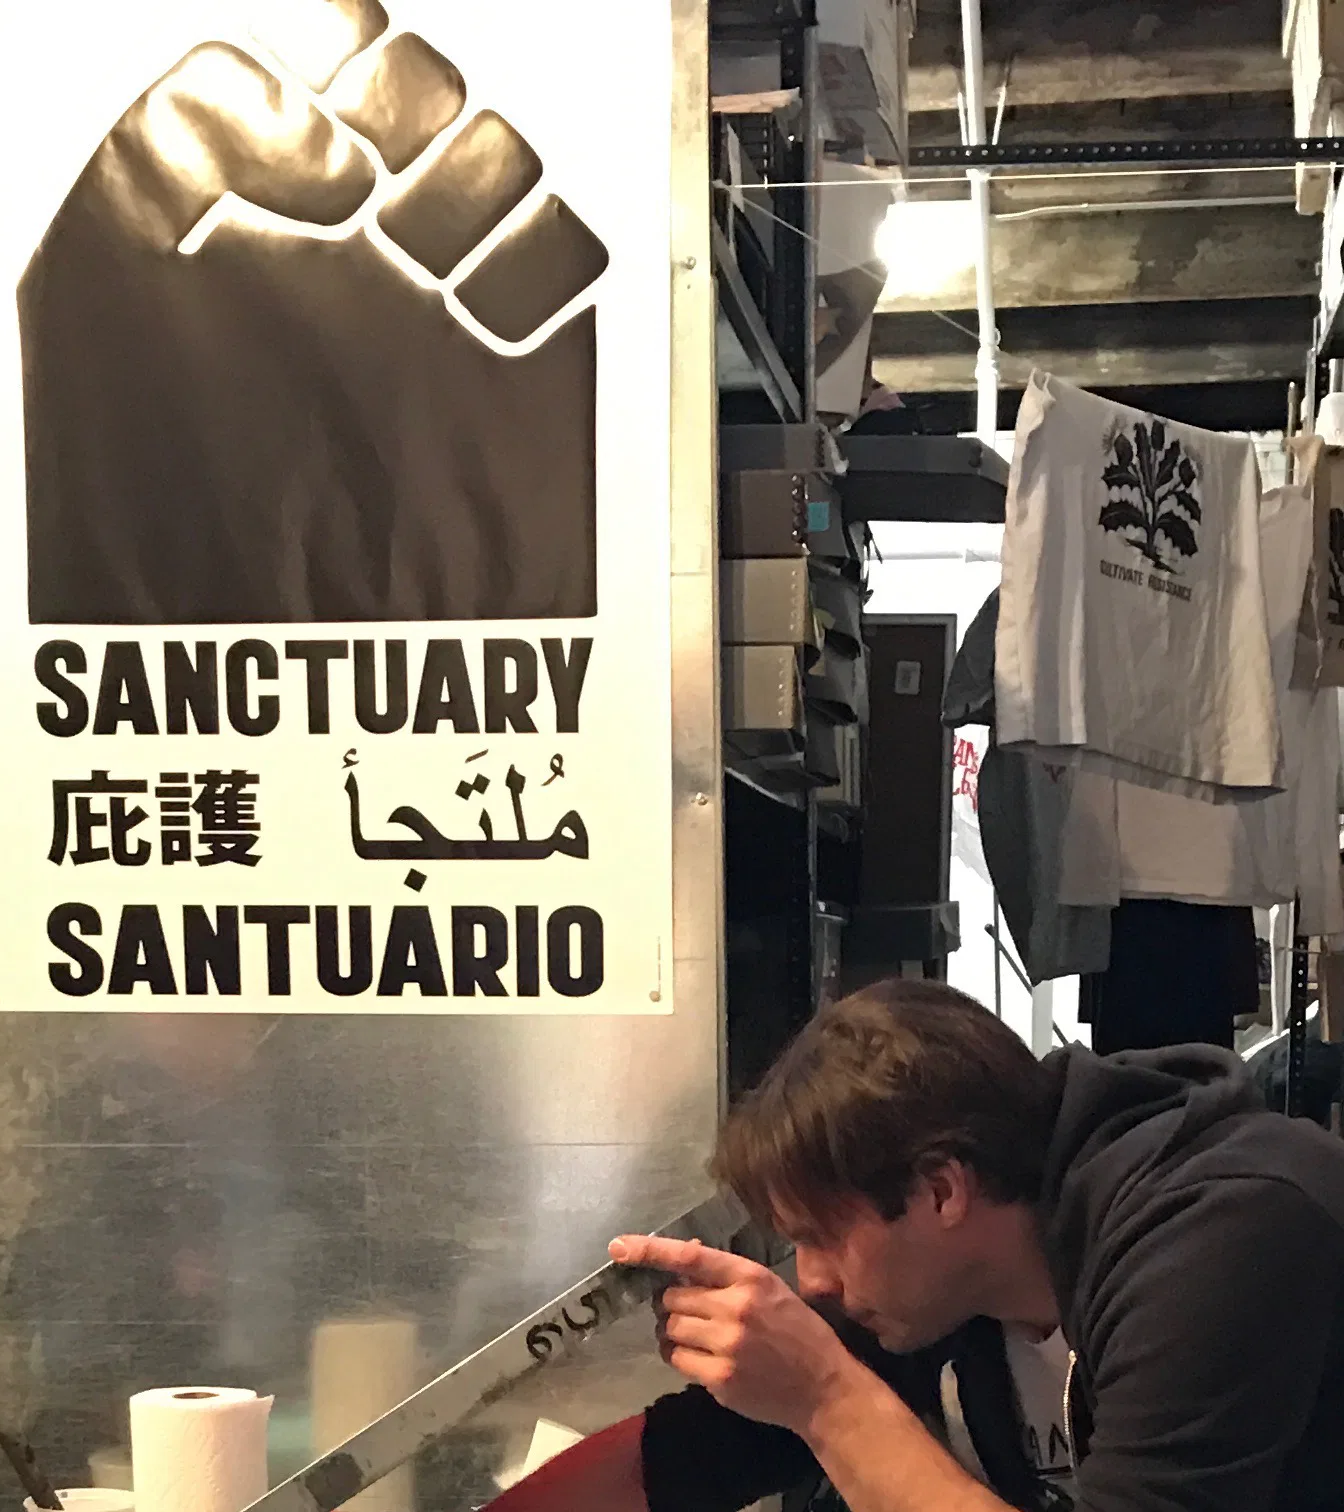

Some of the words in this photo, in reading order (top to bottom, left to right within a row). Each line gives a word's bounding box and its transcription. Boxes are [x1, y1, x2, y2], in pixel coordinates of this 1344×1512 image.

[1099, 559, 1144, 587] CULTIVATE
[33, 636, 594, 739] SANCTUARY
[47, 769, 263, 868] 庇護
[46, 901, 605, 997] SANTUARIO
